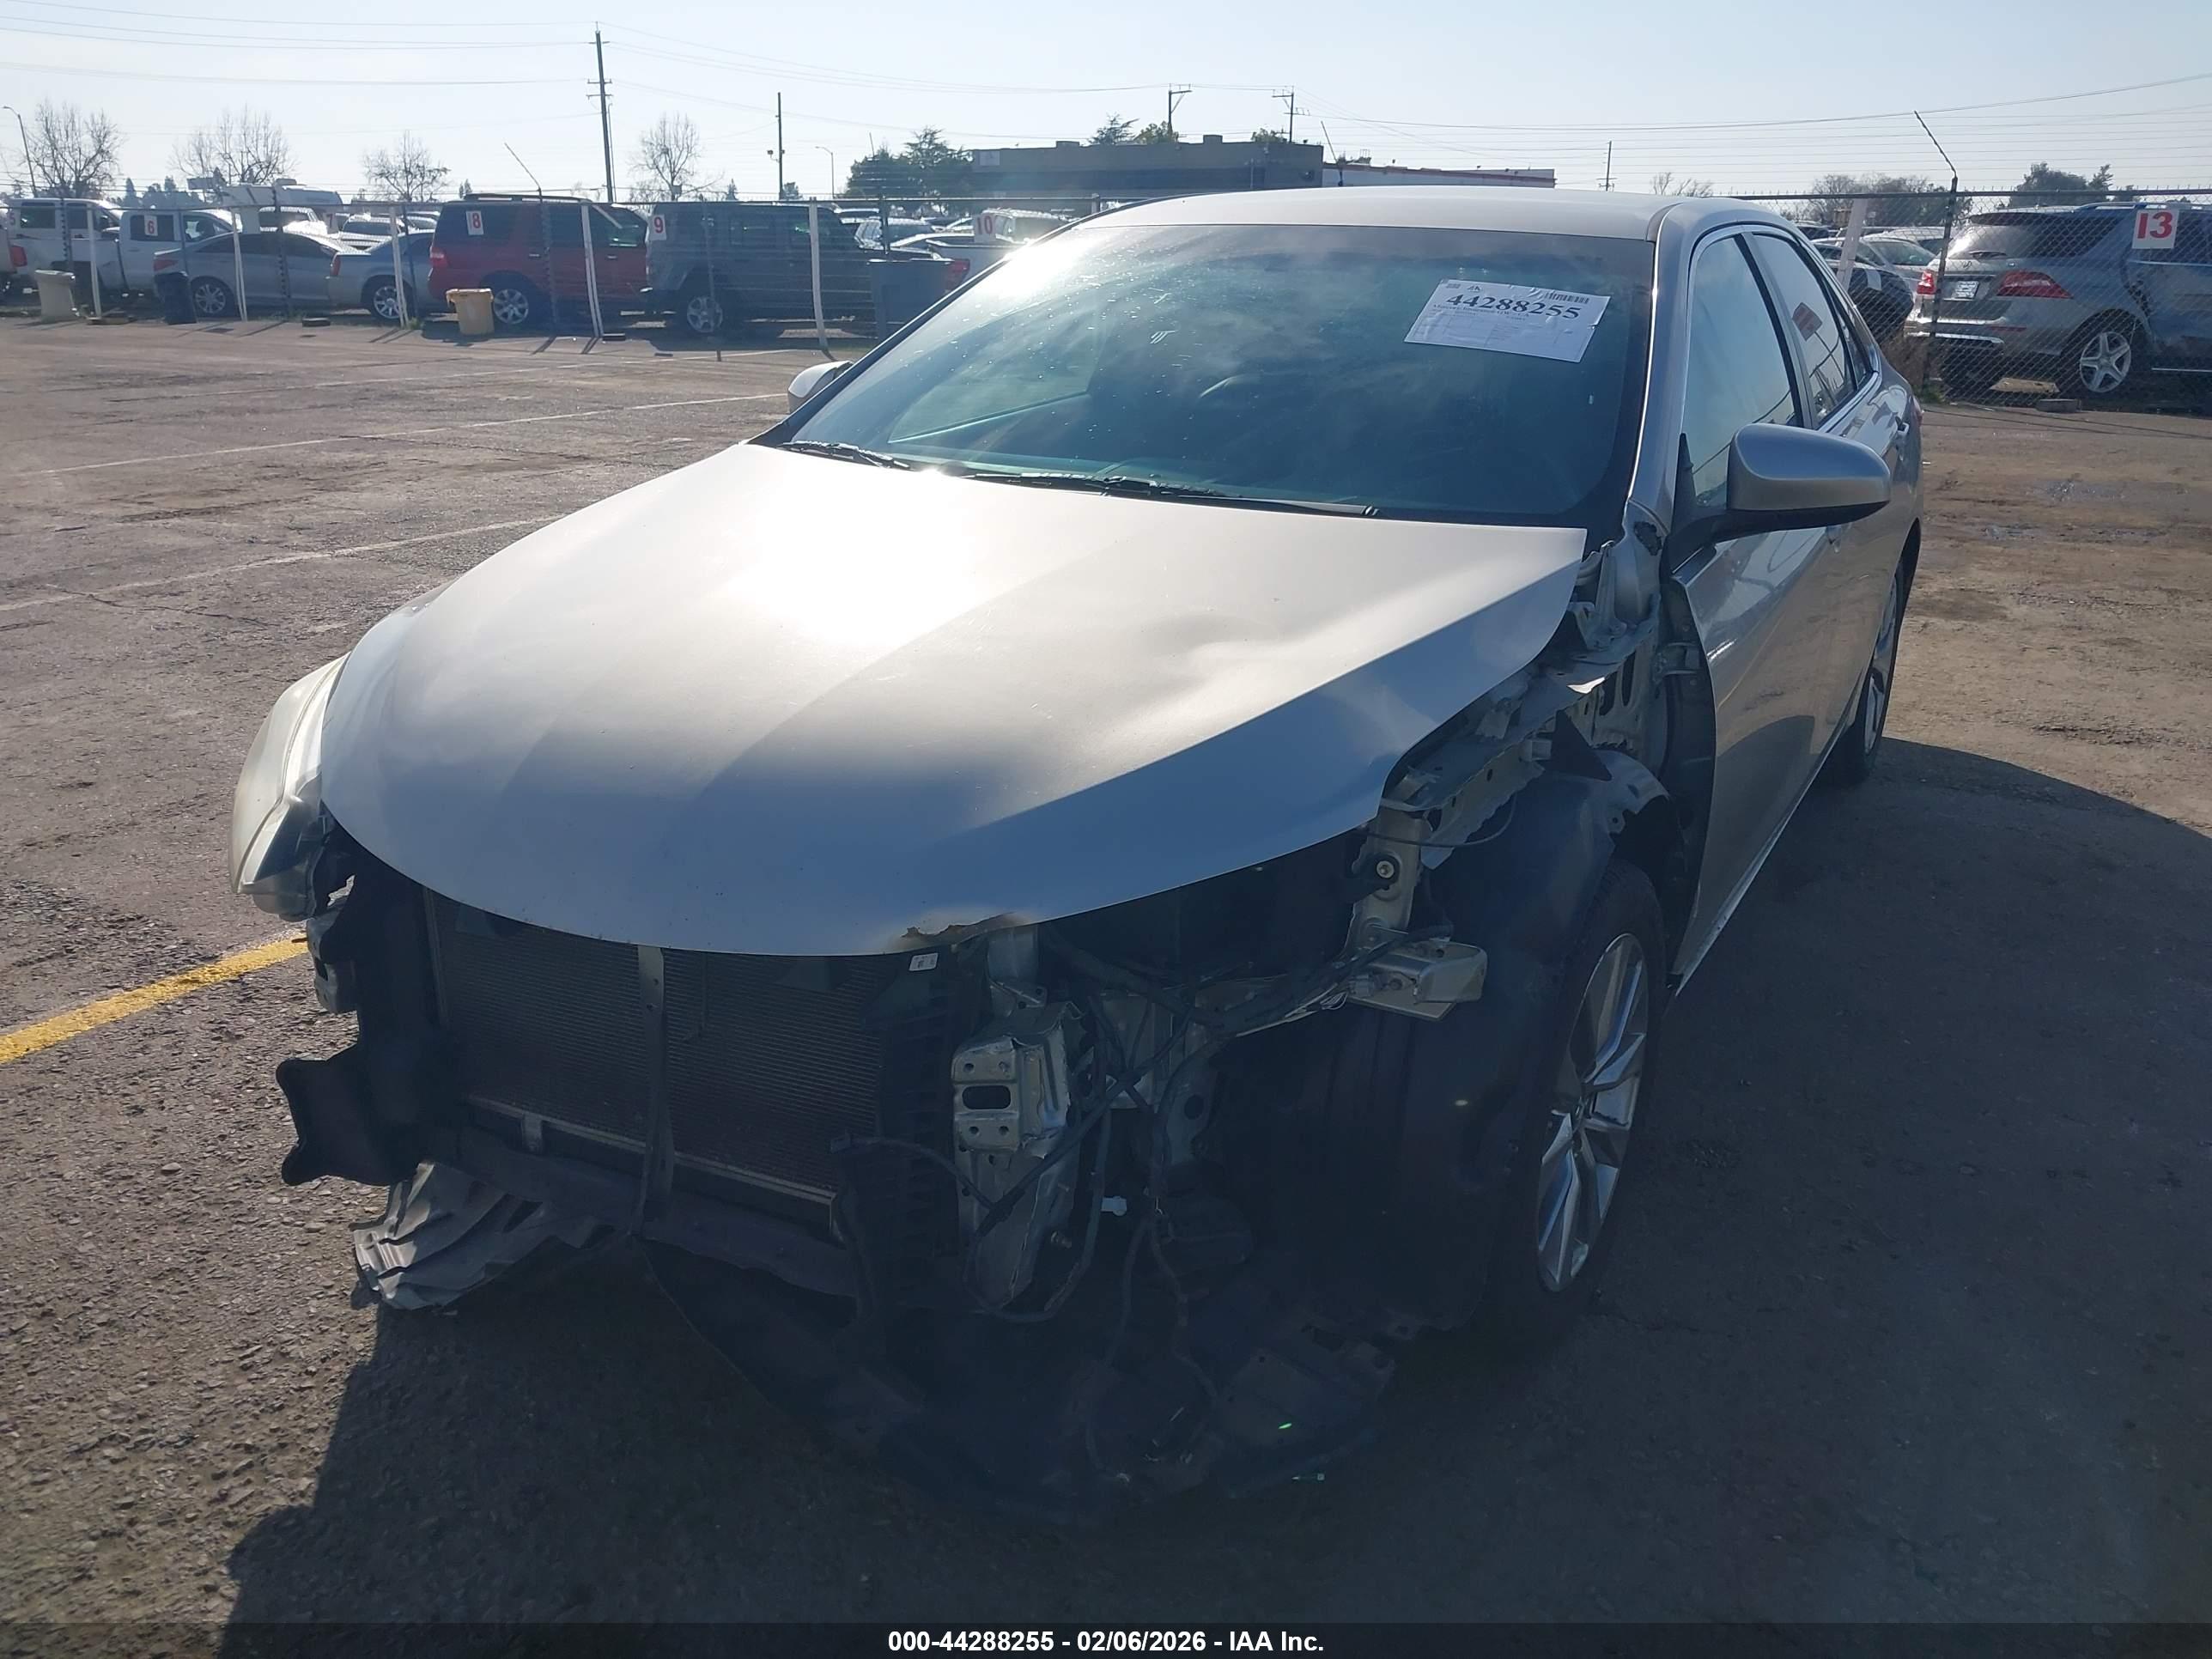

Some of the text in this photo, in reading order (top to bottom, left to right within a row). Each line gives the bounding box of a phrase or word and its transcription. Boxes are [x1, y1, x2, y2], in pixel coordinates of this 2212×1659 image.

[148, 220, 155, 234] 6
[472, 212, 481, 228] 8
[654, 216, 664, 234] 9
[976, 215, 993, 234] 10
[2137, 211, 2172, 239] 13
[1446, 294, 1582, 319] 44288255
